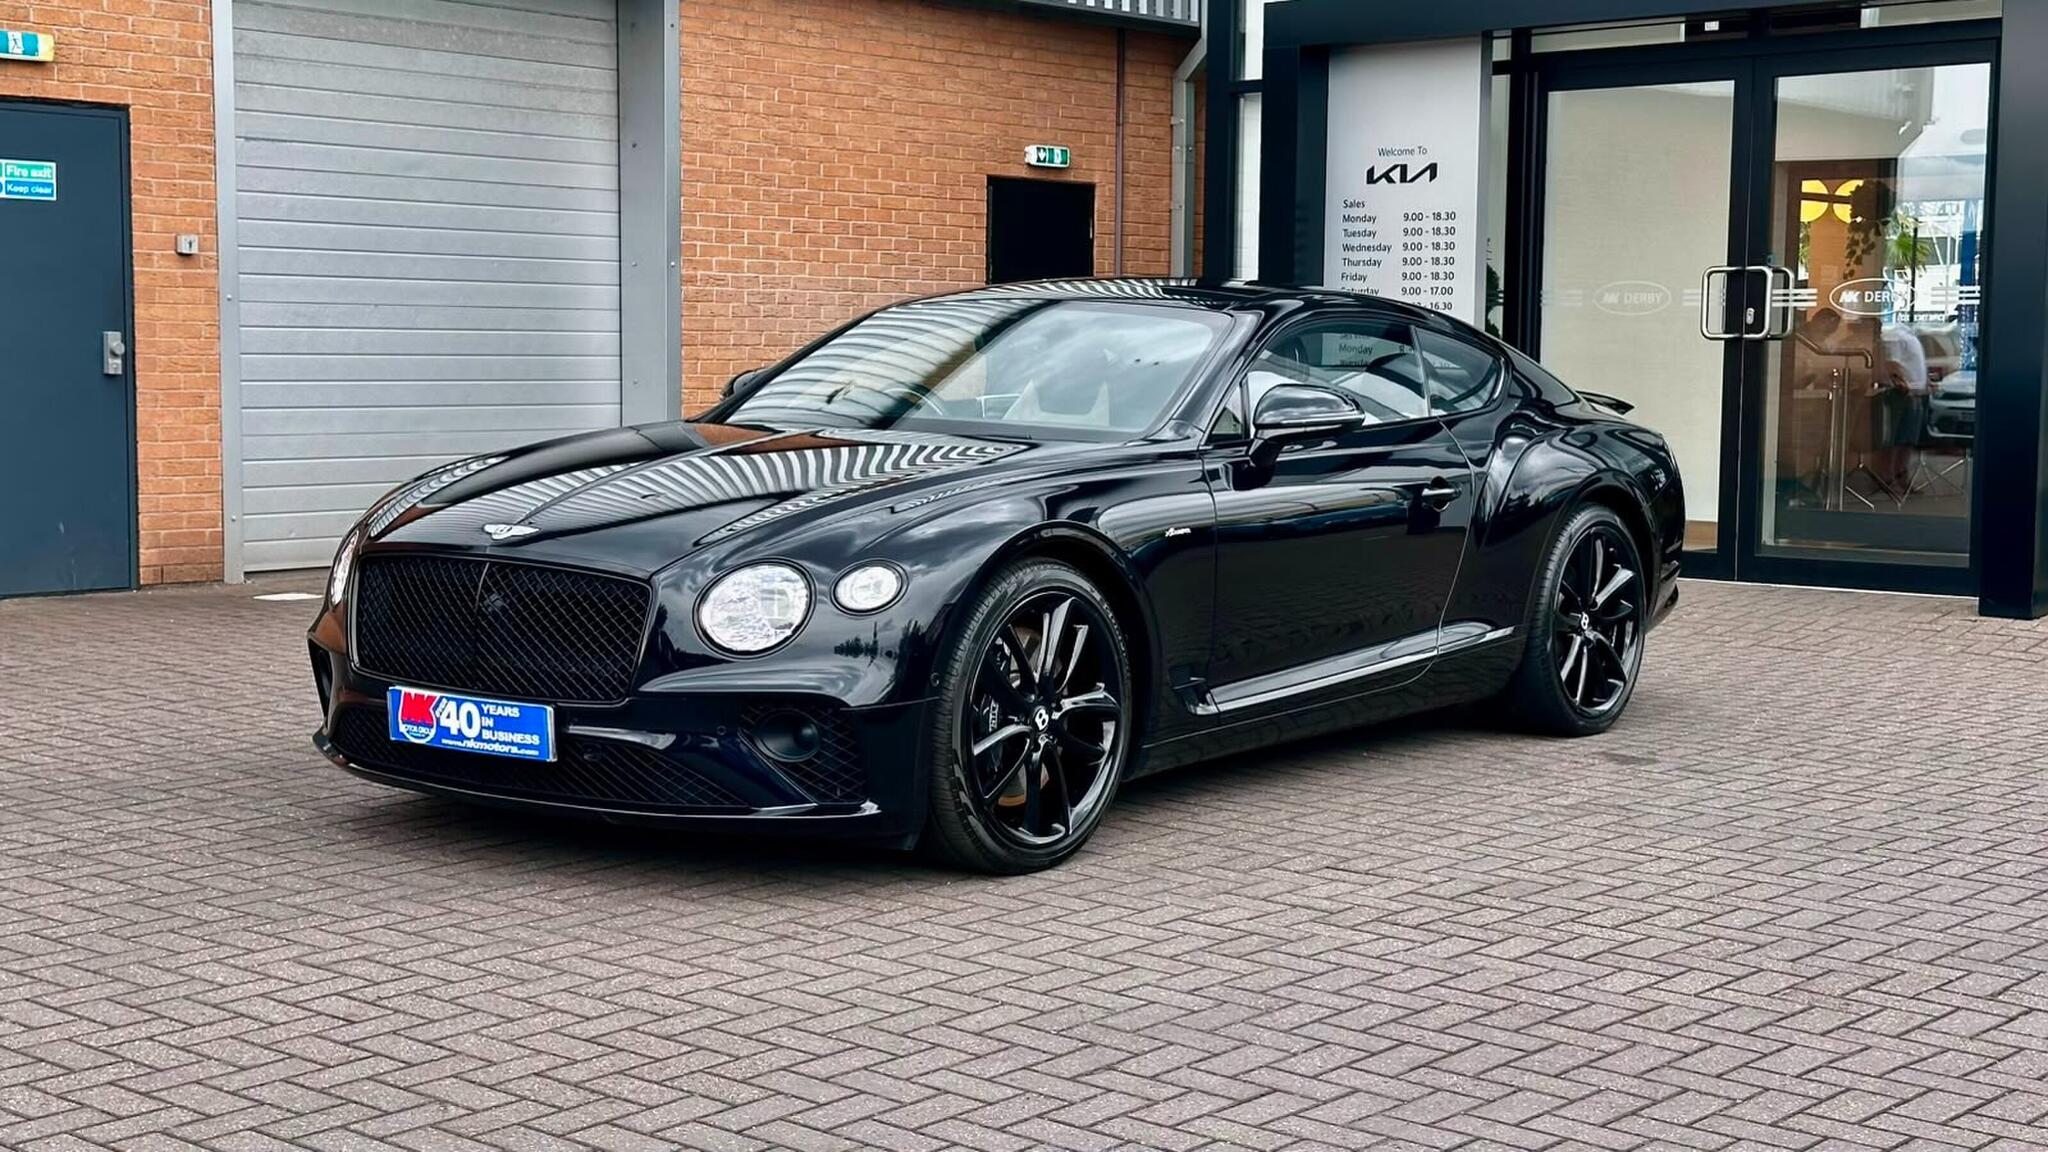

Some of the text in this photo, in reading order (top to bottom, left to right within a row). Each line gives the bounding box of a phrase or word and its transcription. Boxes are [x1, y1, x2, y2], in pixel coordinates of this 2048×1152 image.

[1378, 146, 1428, 157] Welcome To
[6, 164, 29, 177] Fire
[1366, 162, 1438, 185] KIA
[7, 183, 30, 194] Keep
[1343, 200, 1366, 209] Sales
[1342, 213, 1377, 224] Monday
[1403, 212, 1423, 222] 9.00
[1432, 211, 1456, 221] 18.30
[1342, 228, 1377, 239] Tuesday
[1403, 228, 1423, 236] 9.00
[1432, 226, 1456, 236] 18.30
[1342, 243, 1392, 254] Wednesday
[1402, 242, 1422, 252] 9.00
[1431, 242, 1456, 250] 18.30
[1342, 258, 1382, 268] Thursday
[1402, 257, 1422, 266] 9.00
[1430, 256, 1455, 266] 18.30
[1341, 272, 1368, 283] Friday
[1402, 272, 1422, 280] 9.00
[1430, 271, 1454, 280] 18.30
[1401, 286, 1421, 296] 9.00
[1430, 286, 1454, 296] 17.00
[1624, 291, 1663, 304] DERBY
[1429, 302, 1453, 310] 16.30
[1339, 343, 1373, 355] Monday
[481, 703, 520, 718] YEARS
[440, 700, 480, 739] 40
[481, 716, 494, 728] IN
[482, 729, 540, 745] BUSINESS
[441, 738, 539, 756] www.nkmotors.com
